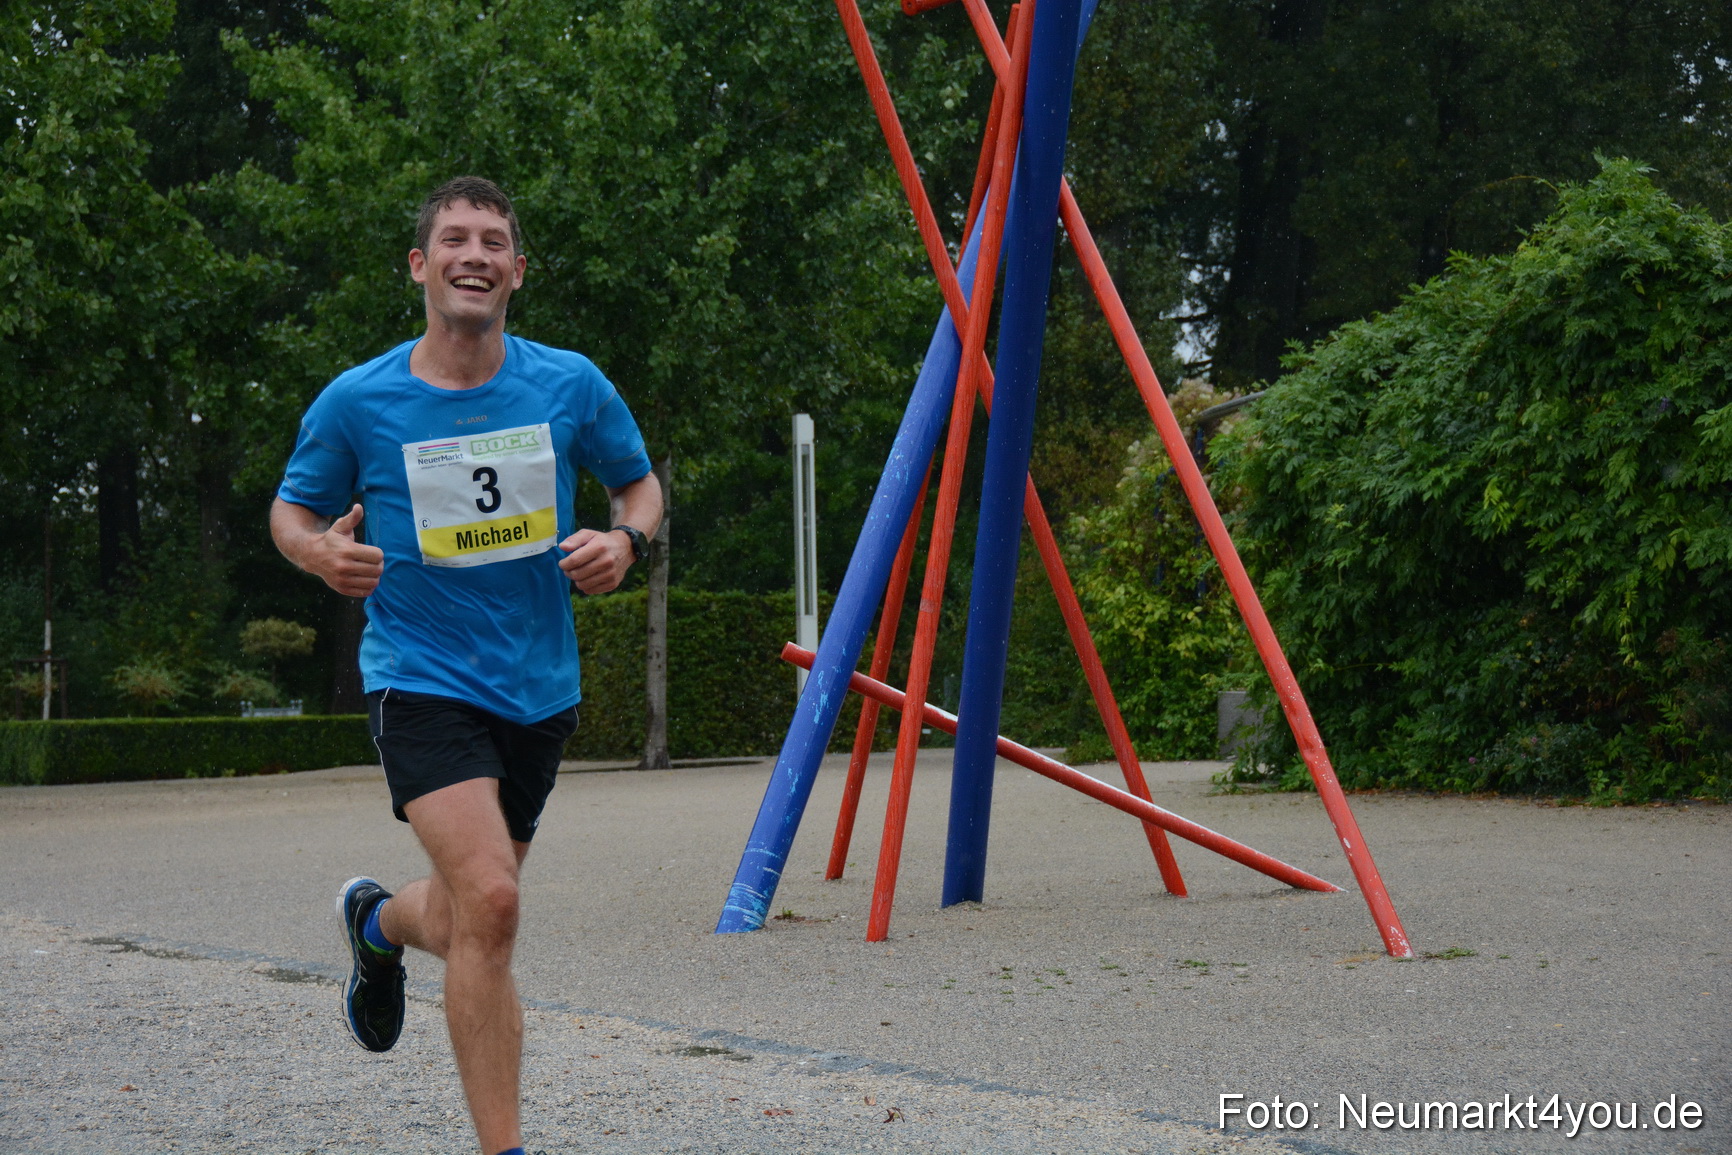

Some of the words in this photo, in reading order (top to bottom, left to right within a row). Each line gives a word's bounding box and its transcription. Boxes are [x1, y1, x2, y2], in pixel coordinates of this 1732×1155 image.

[467, 415, 488, 424] JAKO
[470, 431, 539, 456] BOCK
[417, 453, 464, 465] NeuerMarkt
[472, 467, 502, 513] 3
[456, 521, 529, 550] Michael
